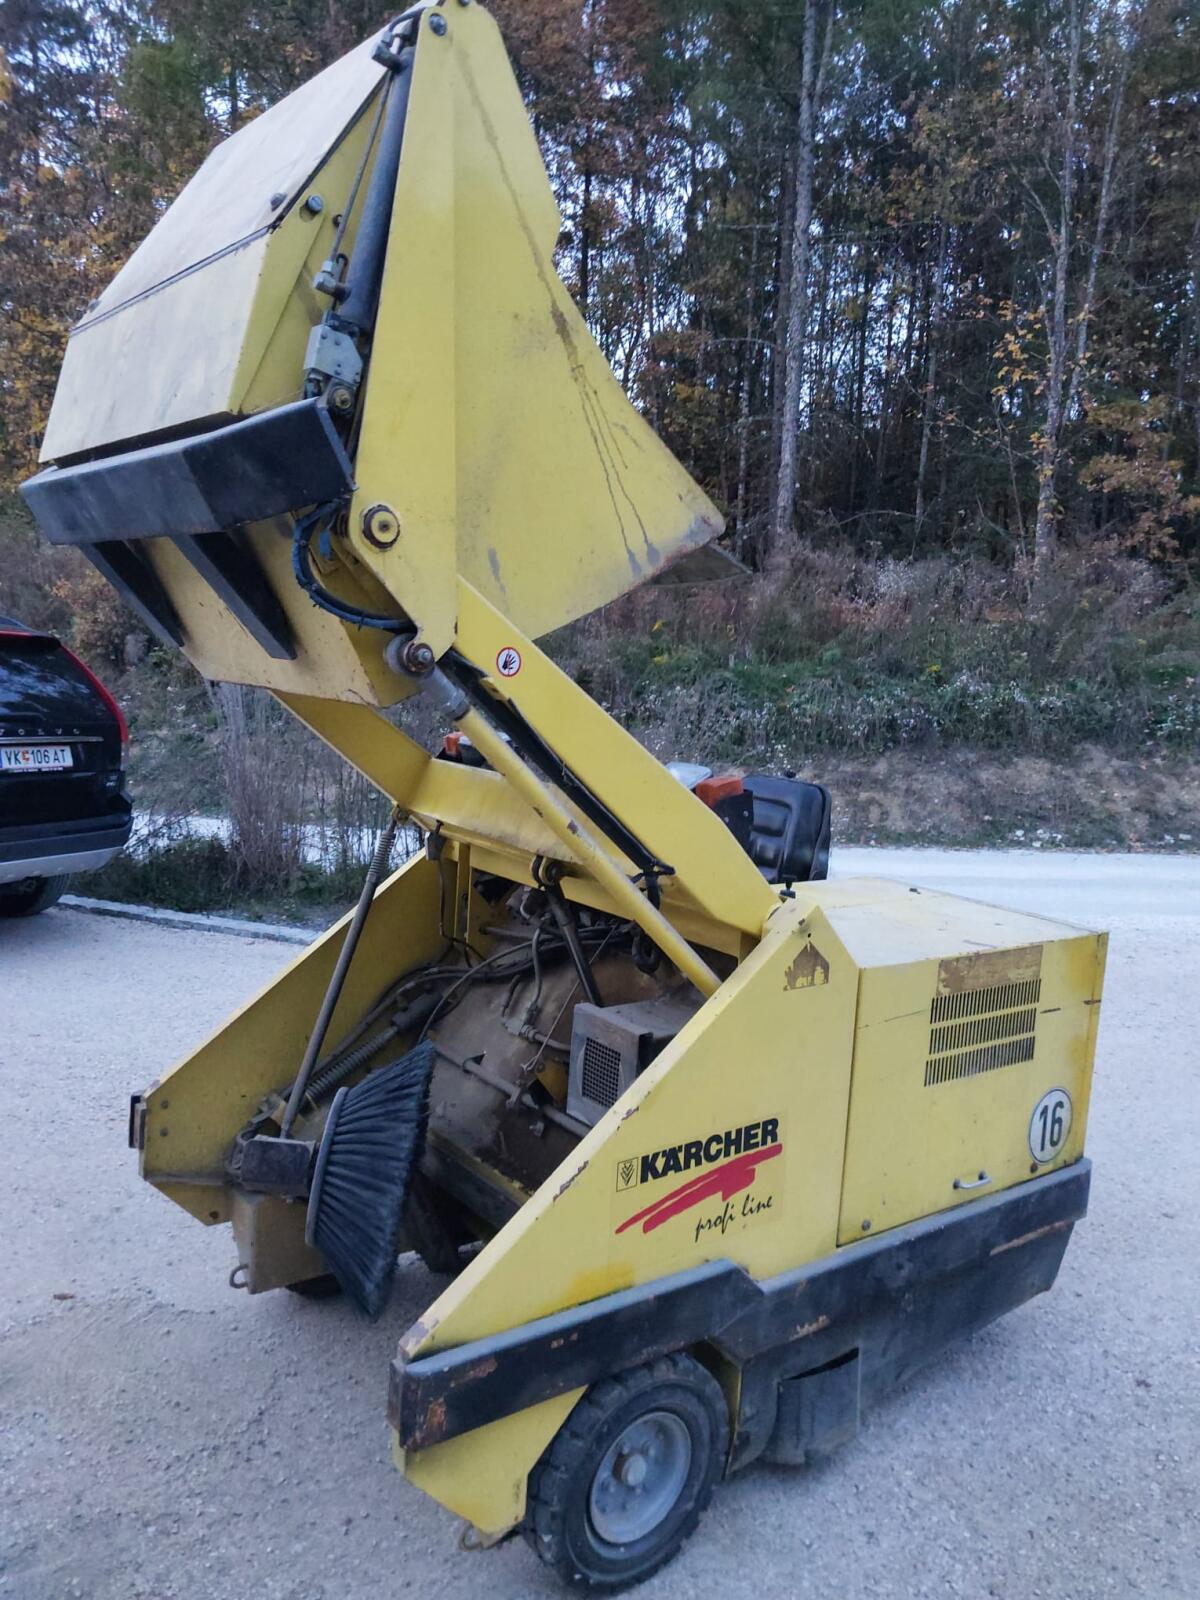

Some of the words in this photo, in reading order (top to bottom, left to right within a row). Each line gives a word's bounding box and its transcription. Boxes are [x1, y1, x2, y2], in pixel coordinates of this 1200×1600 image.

[5, 749, 21, 765] VK
[31, 749, 50, 764] 106
[53, 749, 66, 763] AT
[640, 1118, 779, 1184] KÄRCHER
[1039, 1100, 1064, 1152] 16
[695, 1202, 735, 1242] profi
[741, 1193, 772, 1216] line
